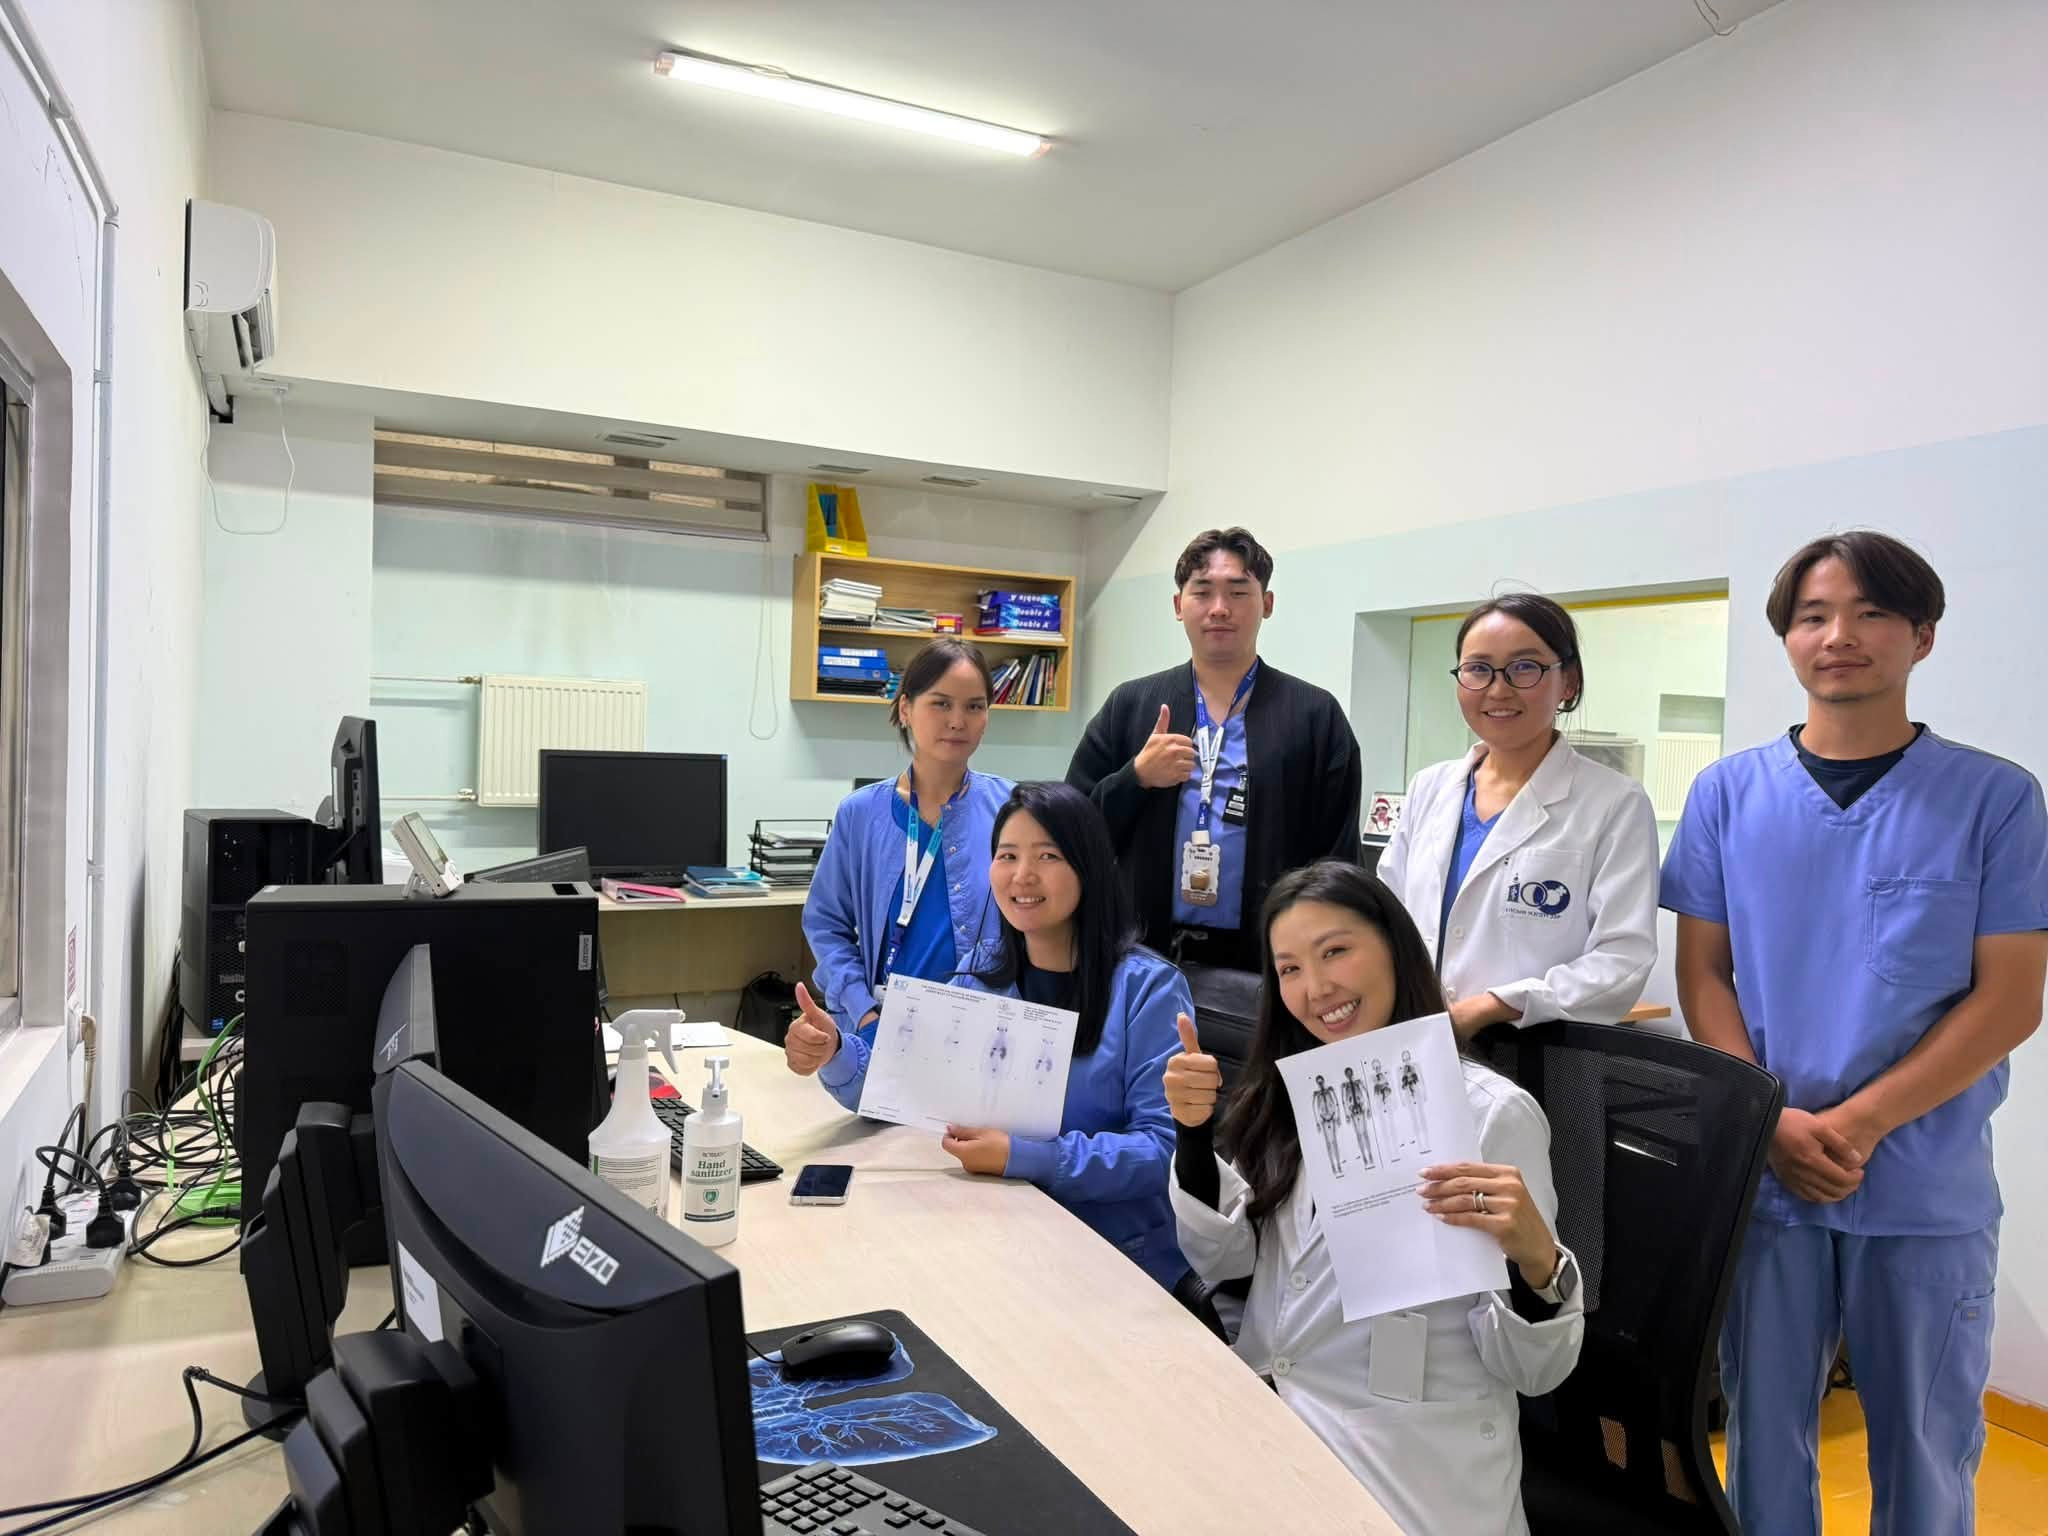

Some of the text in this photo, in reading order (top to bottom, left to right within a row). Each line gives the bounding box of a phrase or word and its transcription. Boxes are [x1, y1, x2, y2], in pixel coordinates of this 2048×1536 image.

[1015, 607, 1051, 617] Double A
[1014, 619, 1049, 629] Double A
[697, 1159, 726, 1169] Hand
[690, 1168, 733, 1178] sanitizer
